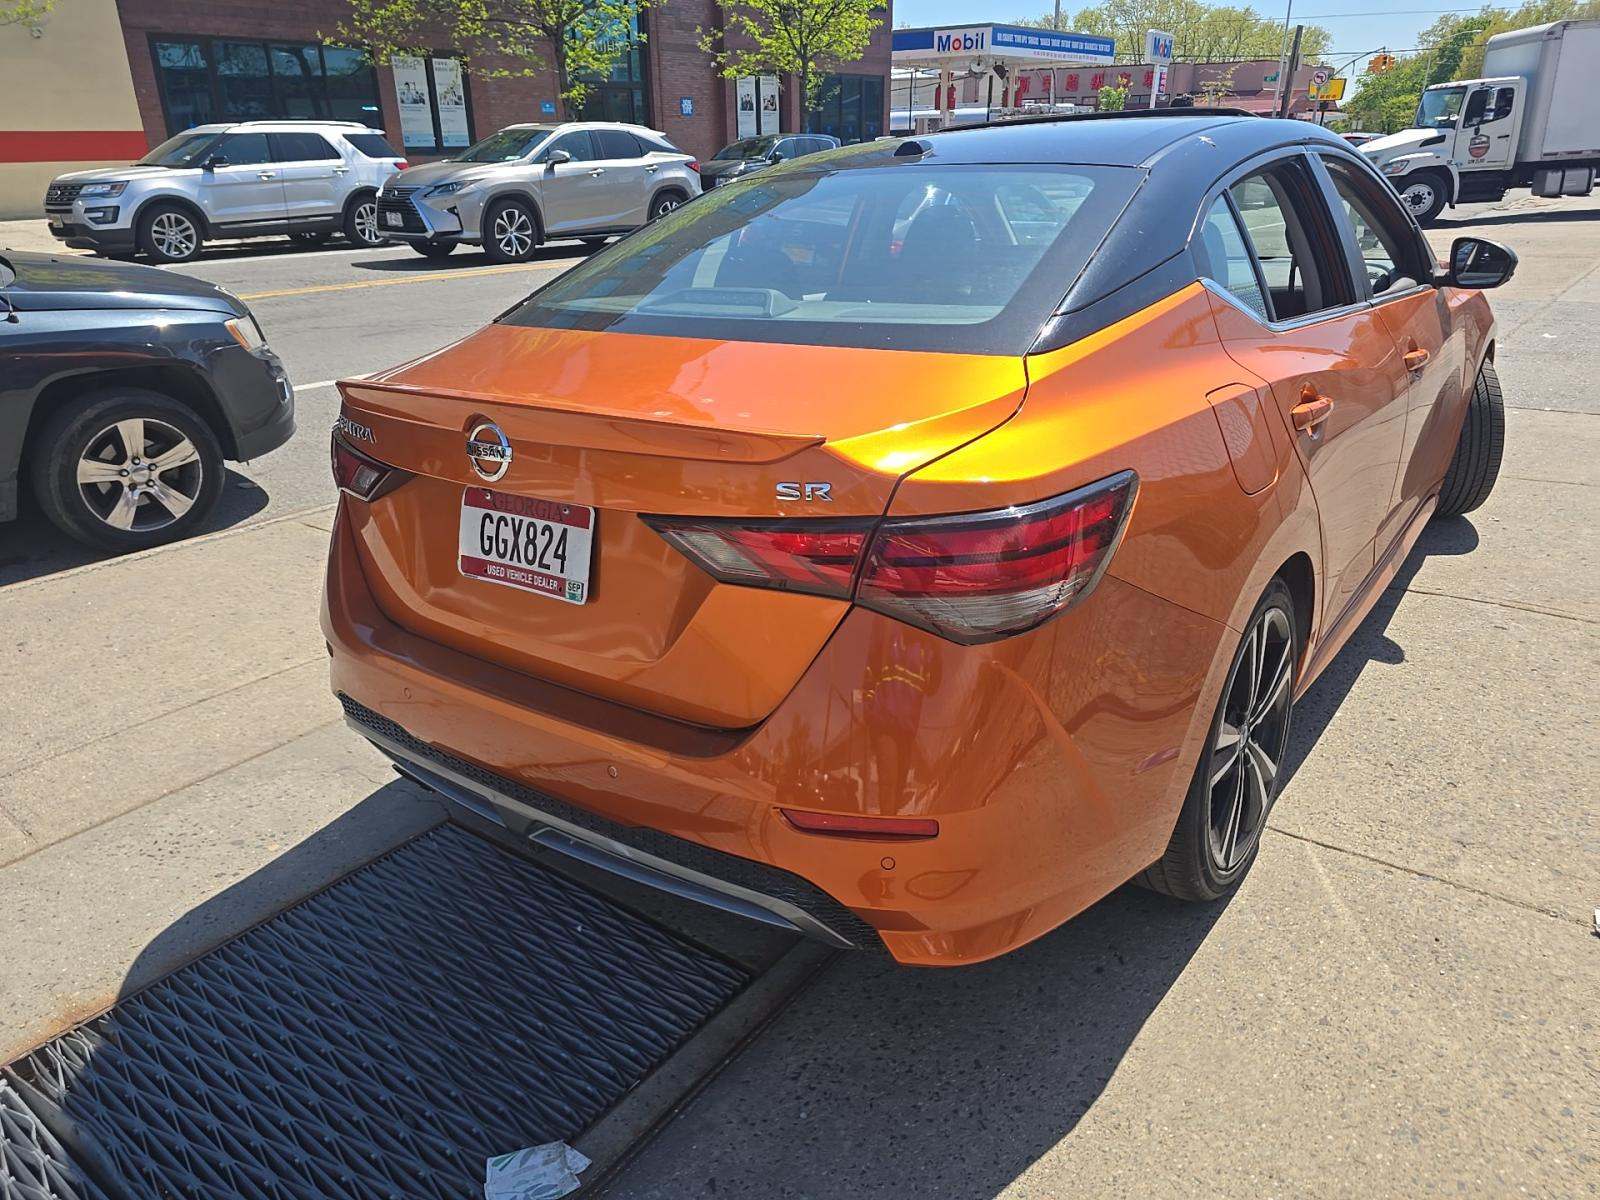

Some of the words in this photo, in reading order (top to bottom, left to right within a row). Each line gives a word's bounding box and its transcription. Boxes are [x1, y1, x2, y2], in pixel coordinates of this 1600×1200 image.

[937, 33, 984, 51] Mobil
[467, 443, 506, 459] NISSAN
[776, 482, 832, 501] SR
[480, 512, 568, 574] GGX824
[487, 564, 505, 577] USED
[506, 568, 533, 584] VEHICLE
[533, 575, 558, 590] DEALER
[568, 582, 581, 592] SEP
